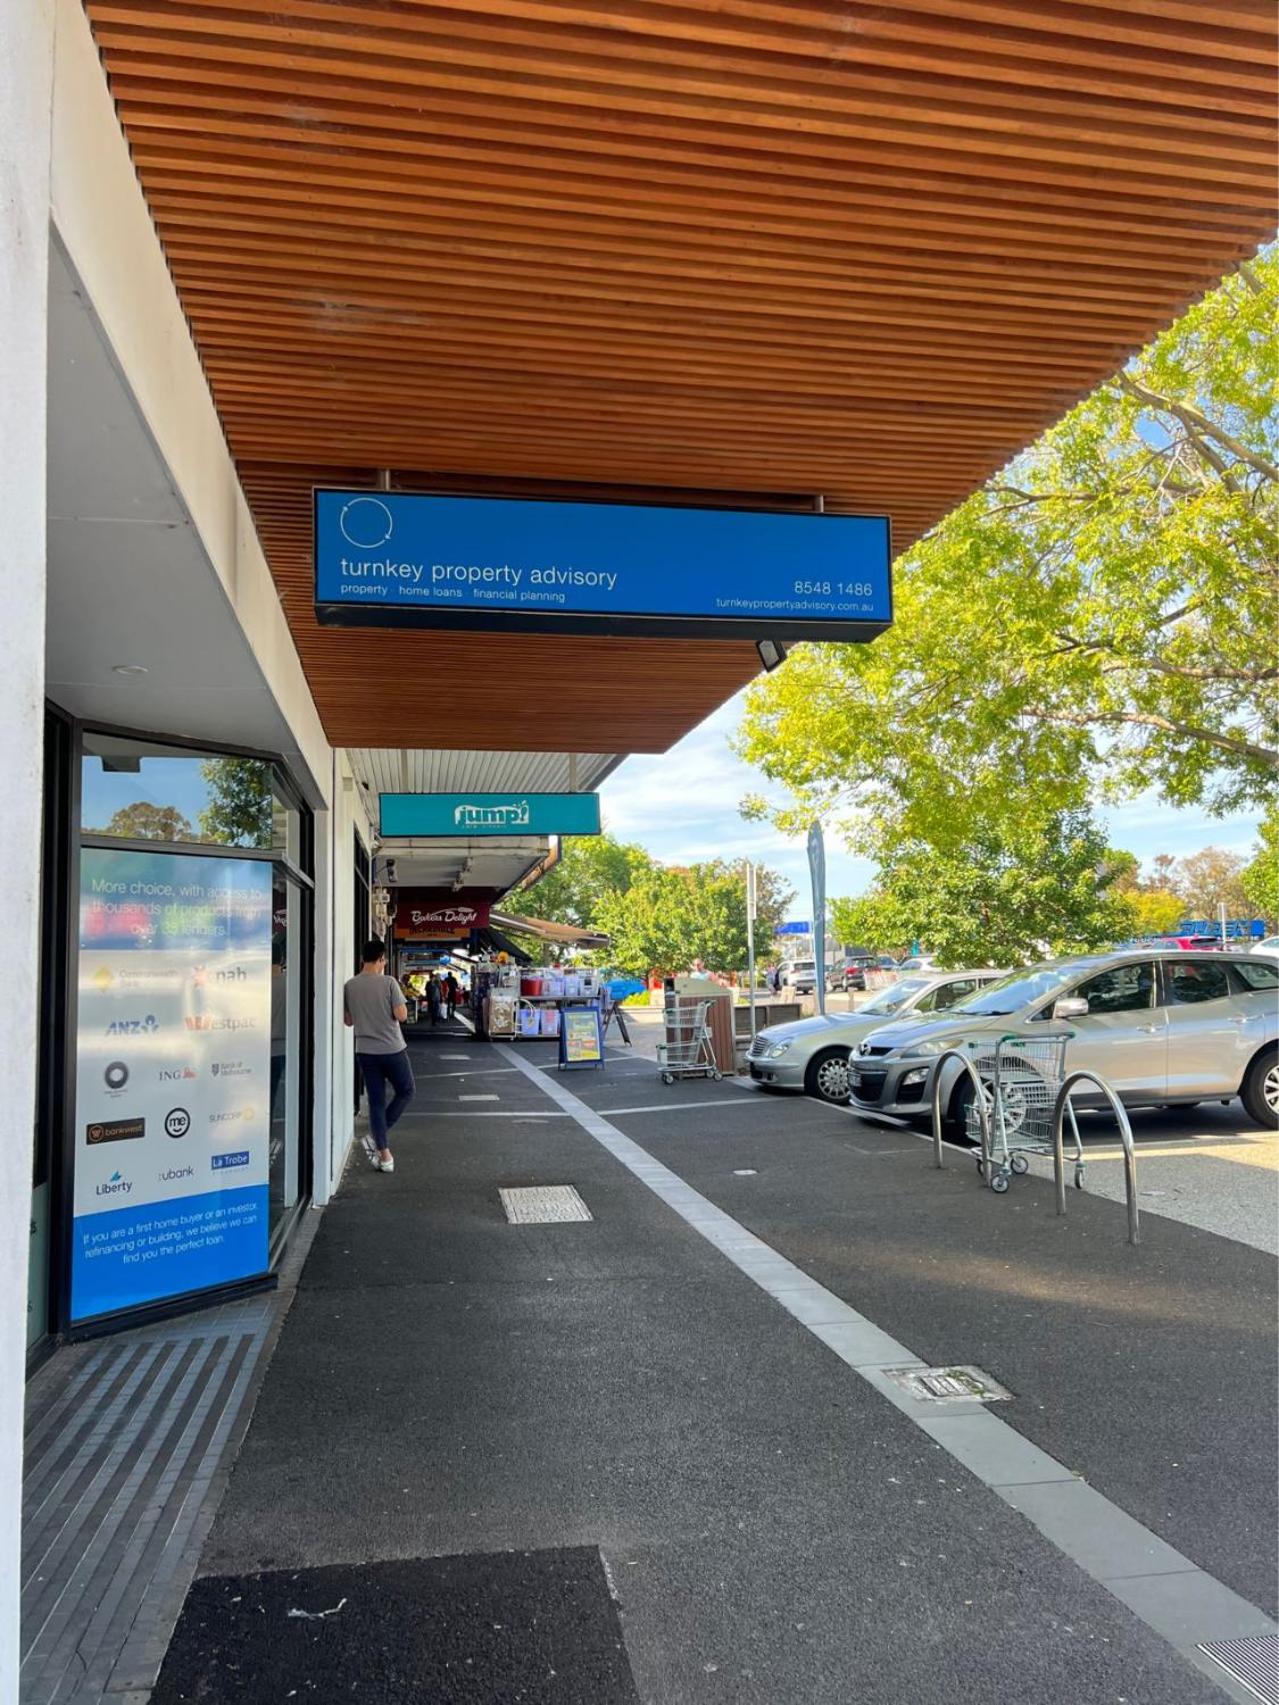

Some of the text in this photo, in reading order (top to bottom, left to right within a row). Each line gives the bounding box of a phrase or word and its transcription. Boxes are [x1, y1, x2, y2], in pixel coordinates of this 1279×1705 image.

[341, 558, 617, 590] turnkey property advisory
[341, 583, 566, 603] property home loans financial planning
[794, 580, 873, 597] 8548 1486
[716, 597, 874, 612] turnkeypropertyadvisory.com.au
[91, 879, 126, 894] More
[129, 880, 176, 897] choice,
[179, 884, 205, 898] with
[444, 911, 477, 925] Delight
[215, 967, 248, 983] nab
[105, 1020, 140, 1036] ANZ
[159, 1069, 182, 1081] ING
[169, 1115, 186, 1127] me
[212, 1153, 249, 1168] La Trobe
[96, 1181, 133, 1196] Liberty
[91, 1230, 109, 1244] you
[110, 1228, 126, 1239] are
[127, 1227, 134, 1236] a
[136, 1222, 152, 1233] first
[153, 1217, 178, 1229] home
[180, 1213, 204, 1227] buyer
[204, 1210, 214, 1220] or
[215, 1208, 226, 1218] an
[84, 1239, 135, 1259] refinancing
[136, 1237, 147, 1248] or
[185, 1227, 199, 1238] we
[200, 1220, 228, 1234] believe
[229, 1218, 243, 1229] we
[243, 1214, 258, 1226] can
[123, 1250, 140, 1264] find
[141, 1247, 159, 1262] you
[160, 1245, 174, 1256] the
[175, 1237, 205, 1253] perfect
